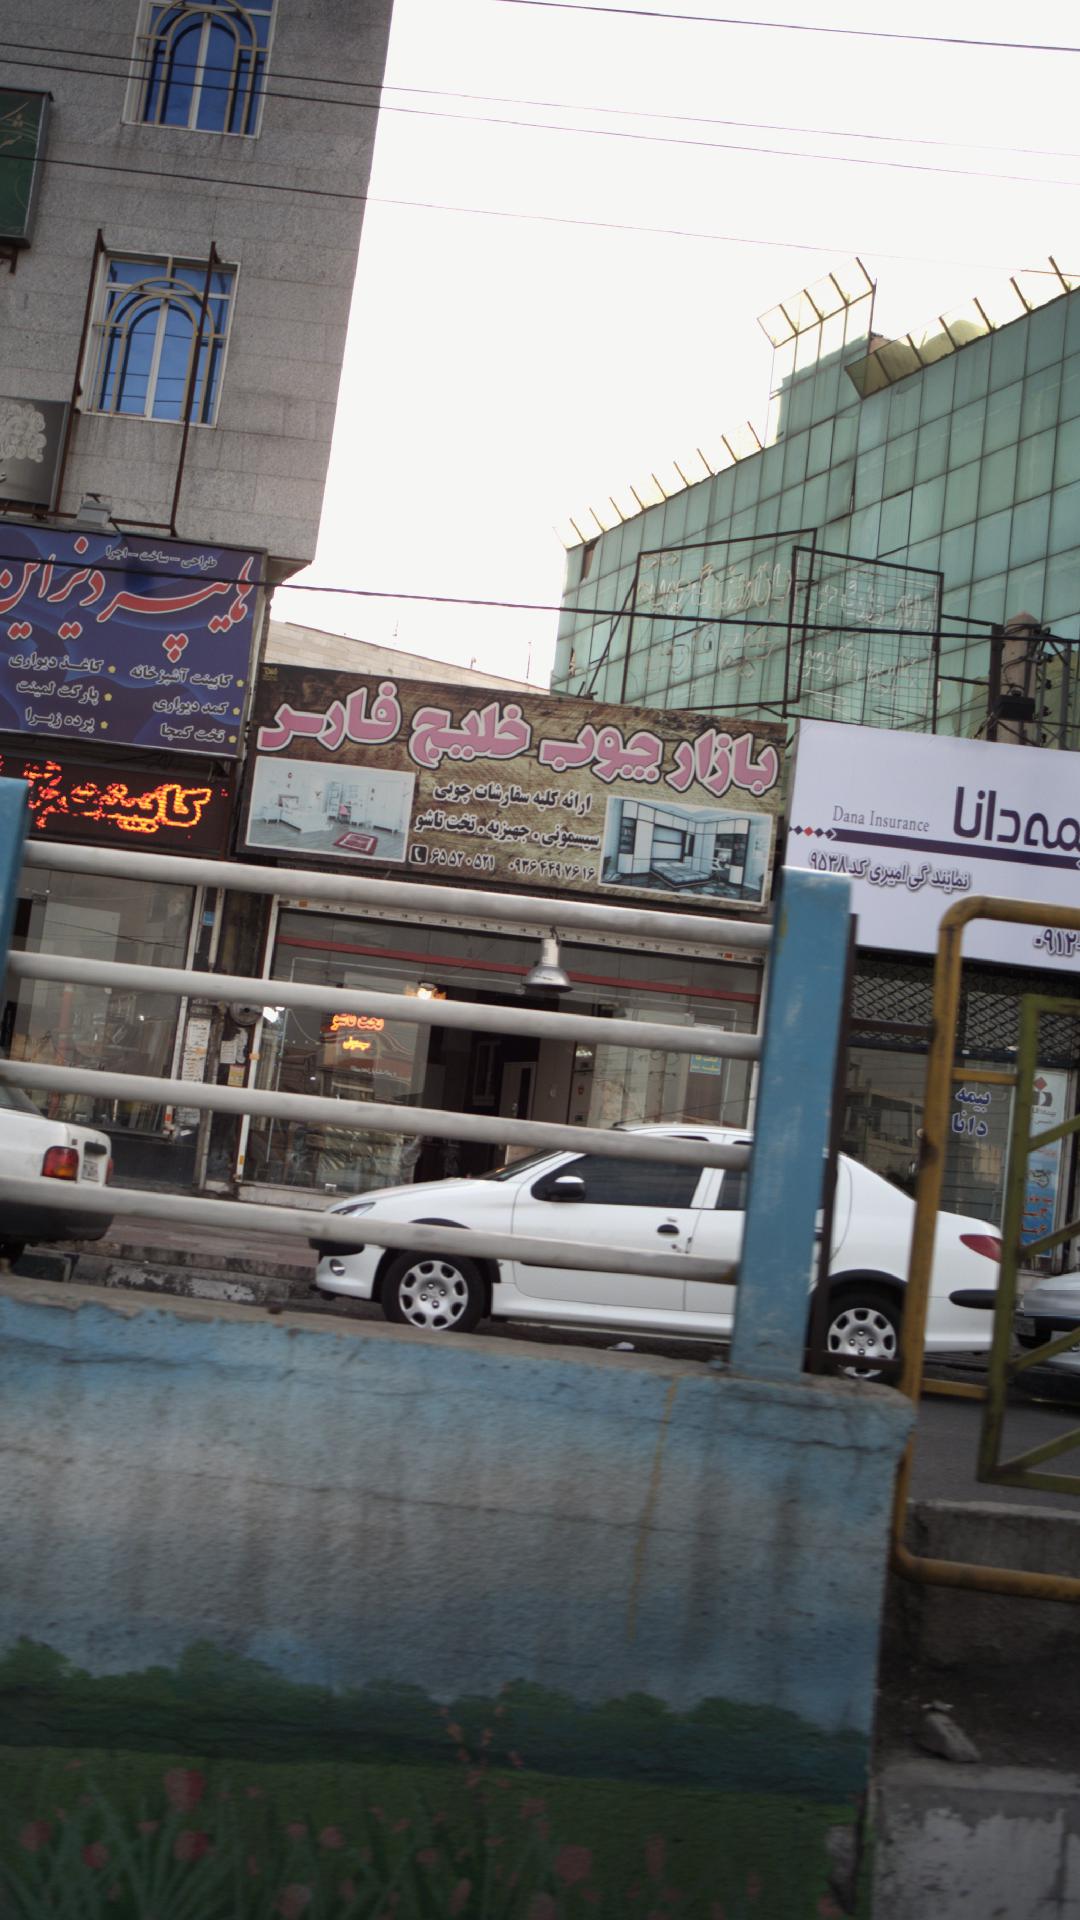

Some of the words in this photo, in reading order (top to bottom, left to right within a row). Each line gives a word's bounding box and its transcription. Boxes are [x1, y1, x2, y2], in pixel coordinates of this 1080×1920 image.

[105, 545, 129, 560] اجرا
[139, 550, 169, 563] ساخت
[181, 554, 217, 570] طراحی
[8, 652, 58, 671] دیواری
[59, 655, 104, 673] کاغذ
[16, 680, 56, 697] لمینت
[190, 673, 233, 689] کابینت
[57, 684, 99, 706] پارکت
[152, 696, 200, 715] دیواری
[25, 706, 62, 728] زبرا
[201, 702, 230, 715] کمد
[256, 680, 401, 751] فارس
[64, 715, 95, 733] پرده
[160, 722, 194, 741] کمجا
[194, 728, 226, 743] تخت
[408, 702, 530, 769] خلیج
[539, 723, 664, 783] چوب
[665, 728, 779, 797] بازار
[434, 783, 472, 803] چوبی
[475, 782, 530, 807] سفارشات
[533, 790, 560, 811] کلیه
[562, 793, 592, 815] ارائه
[415, 810, 444, 833] تاشو
[445, 814, 478, 834] تخت
[832, 805, 865, 825] Dana
[869, 810, 930, 832] Insurance
[953, 786, 1021, 843] دانا
[487, 820, 530, 843] جهیزیه
[541, 825, 600, 851] سیسمونی
[869, 864, 908, 888] امیری
[908, 864, 970, 893] نمایندگی
[955, 1088, 991, 1113] بیمه
[952, 1110, 988, 1136] دانا
